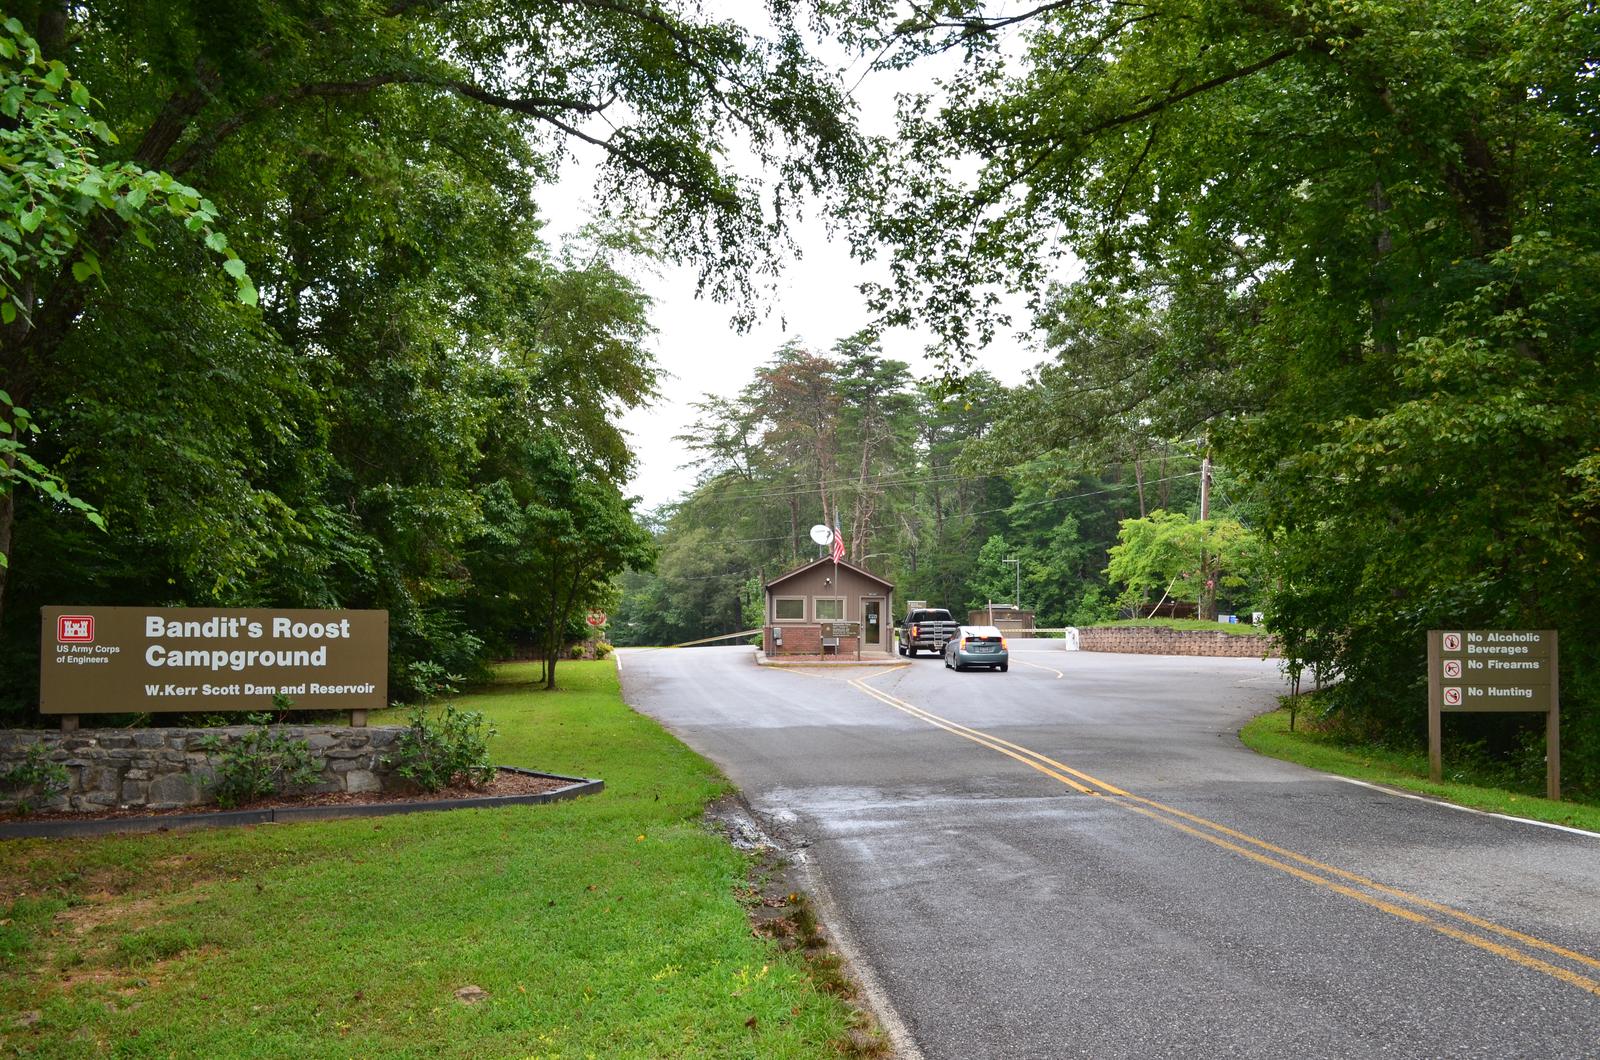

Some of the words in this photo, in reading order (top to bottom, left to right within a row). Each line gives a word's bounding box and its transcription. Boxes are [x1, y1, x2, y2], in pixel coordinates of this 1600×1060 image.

[145, 616, 263, 638] Bandit's
[273, 617, 350, 639] Roost
[1467, 633, 1483, 642] No
[1487, 632, 1540, 642] Alcoholic
[56, 645, 69, 653] US
[71, 645, 94, 654] Army
[95, 645, 120, 654] Corps
[1467, 644, 1529, 655] Beverages
[67, 656, 109, 665] Engineers
[145, 645, 327, 671] Campground
[1468, 660, 1483, 669] No
[1488, 660, 1540, 669] Firearms
[145, 684, 198, 696] W.Kerr
[202, 684, 240, 695] Scott
[244, 683, 276, 695] Dam
[280, 683, 306, 694] and
[310, 682, 375, 694] Reservoir
[1468, 687, 1483, 696] No
[1488, 687, 1532, 698] Hunting
